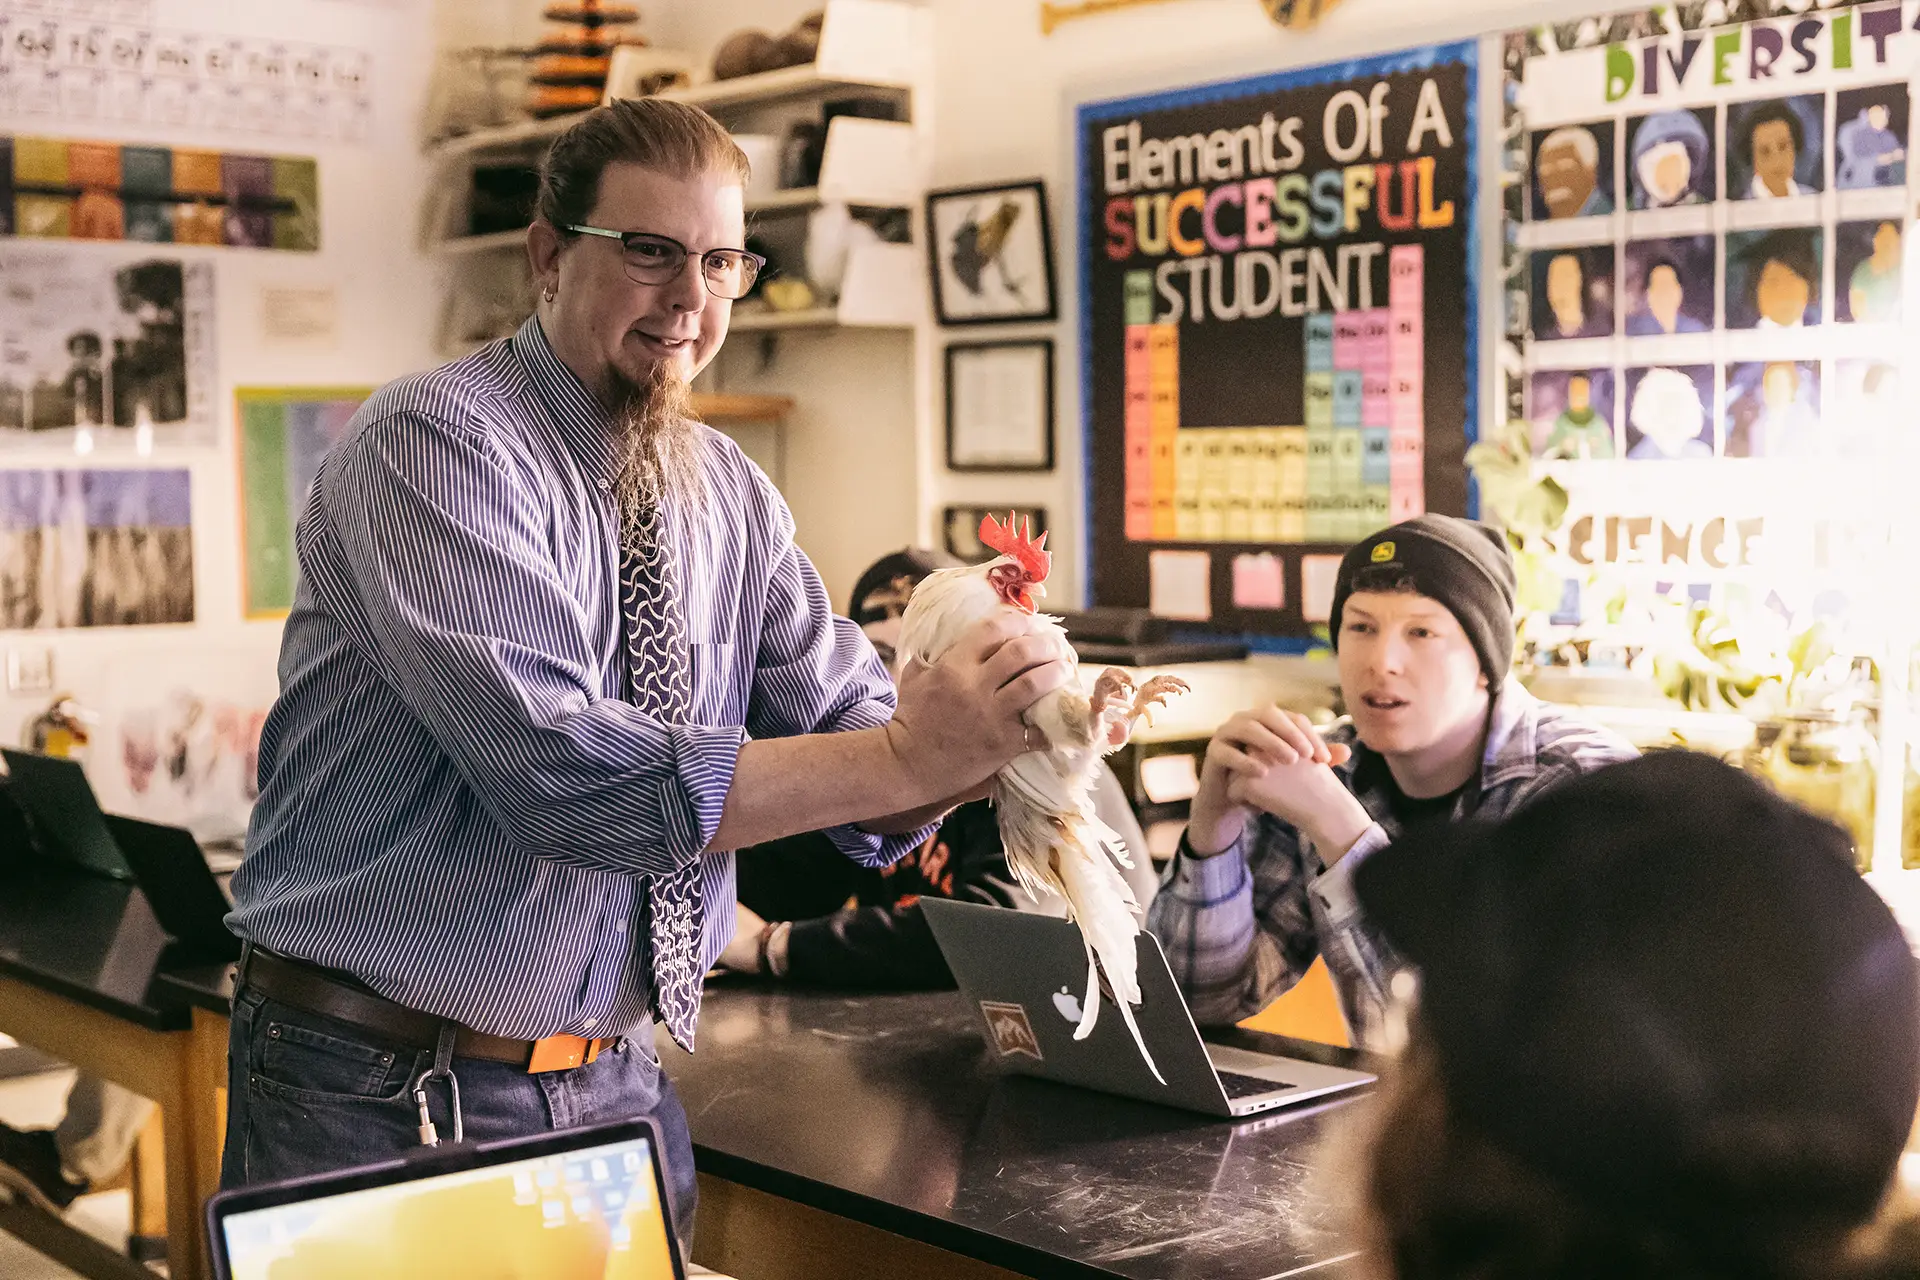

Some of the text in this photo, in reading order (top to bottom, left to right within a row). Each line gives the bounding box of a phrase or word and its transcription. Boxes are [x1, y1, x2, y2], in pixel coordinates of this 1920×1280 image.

[1604, 7, 1920, 103] DIVERSIT
[1103, 78, 1453, 194] Elements Of A
[1104, 156, 1454, 260] SUCCESSFUL
[1153, 241, 1386, 325] STUDENT
